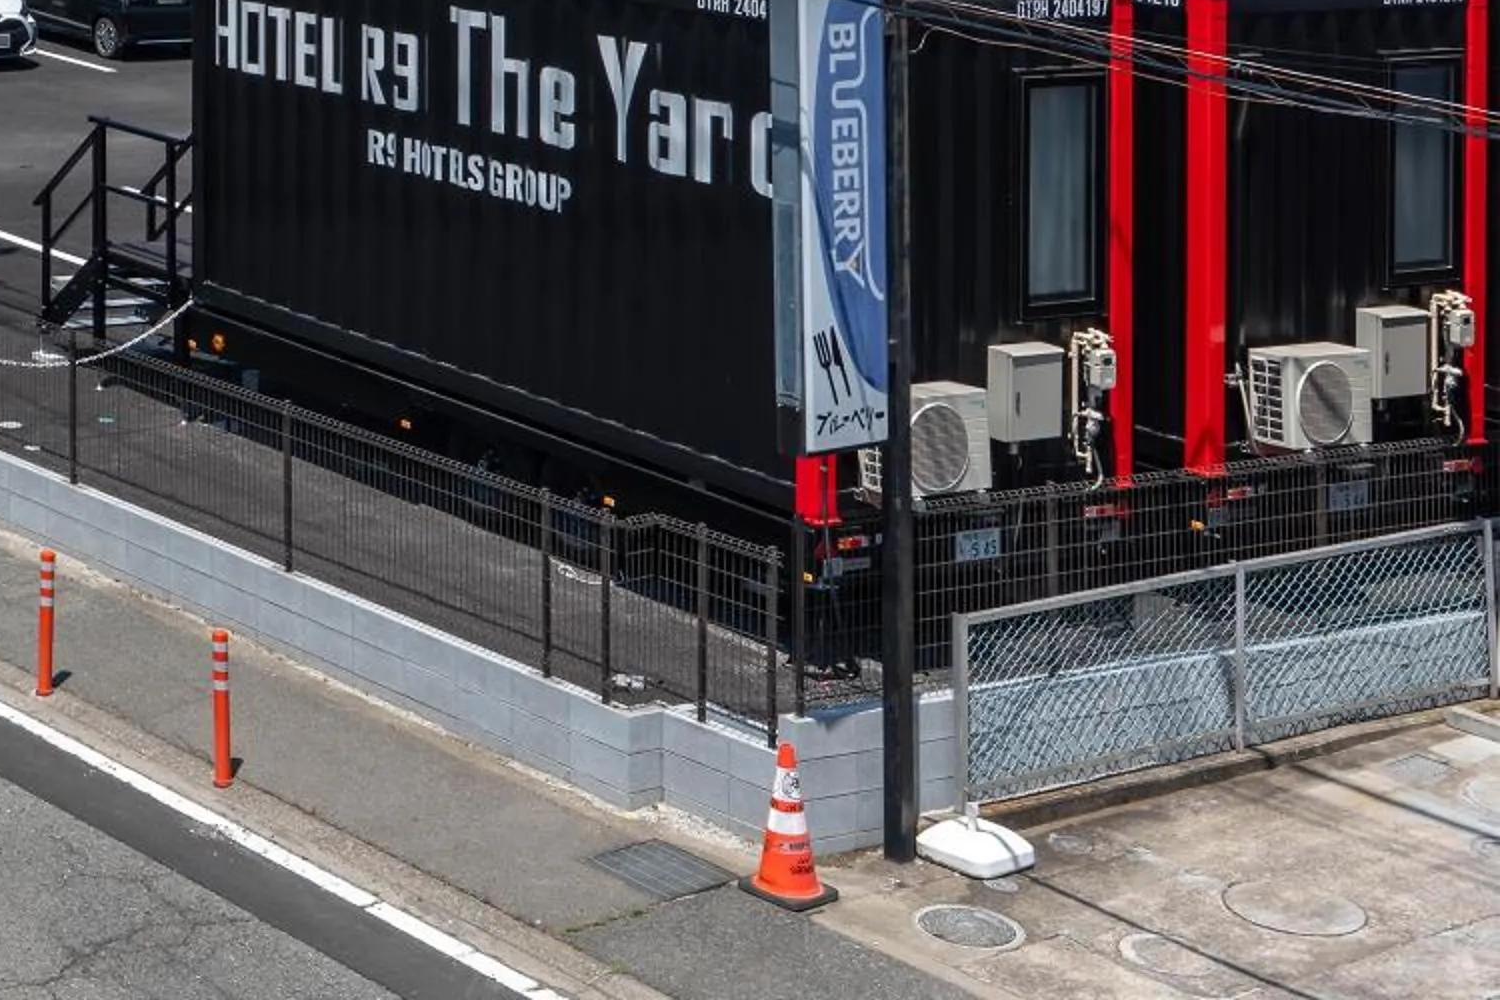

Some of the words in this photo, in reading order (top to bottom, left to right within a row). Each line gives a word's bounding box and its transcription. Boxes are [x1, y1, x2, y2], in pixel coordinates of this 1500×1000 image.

[361, 23, 420, 113] R9
[450, 5, 576, 151] The
[367, 128, 397, 169] R9
[403, 137, 485, 192] HOTELS
[489, 158, 572, 214] GROUP
[827, 22, 867, 289] BLUEBERRY
[816, 407, 885, 436] ブルーベリー
